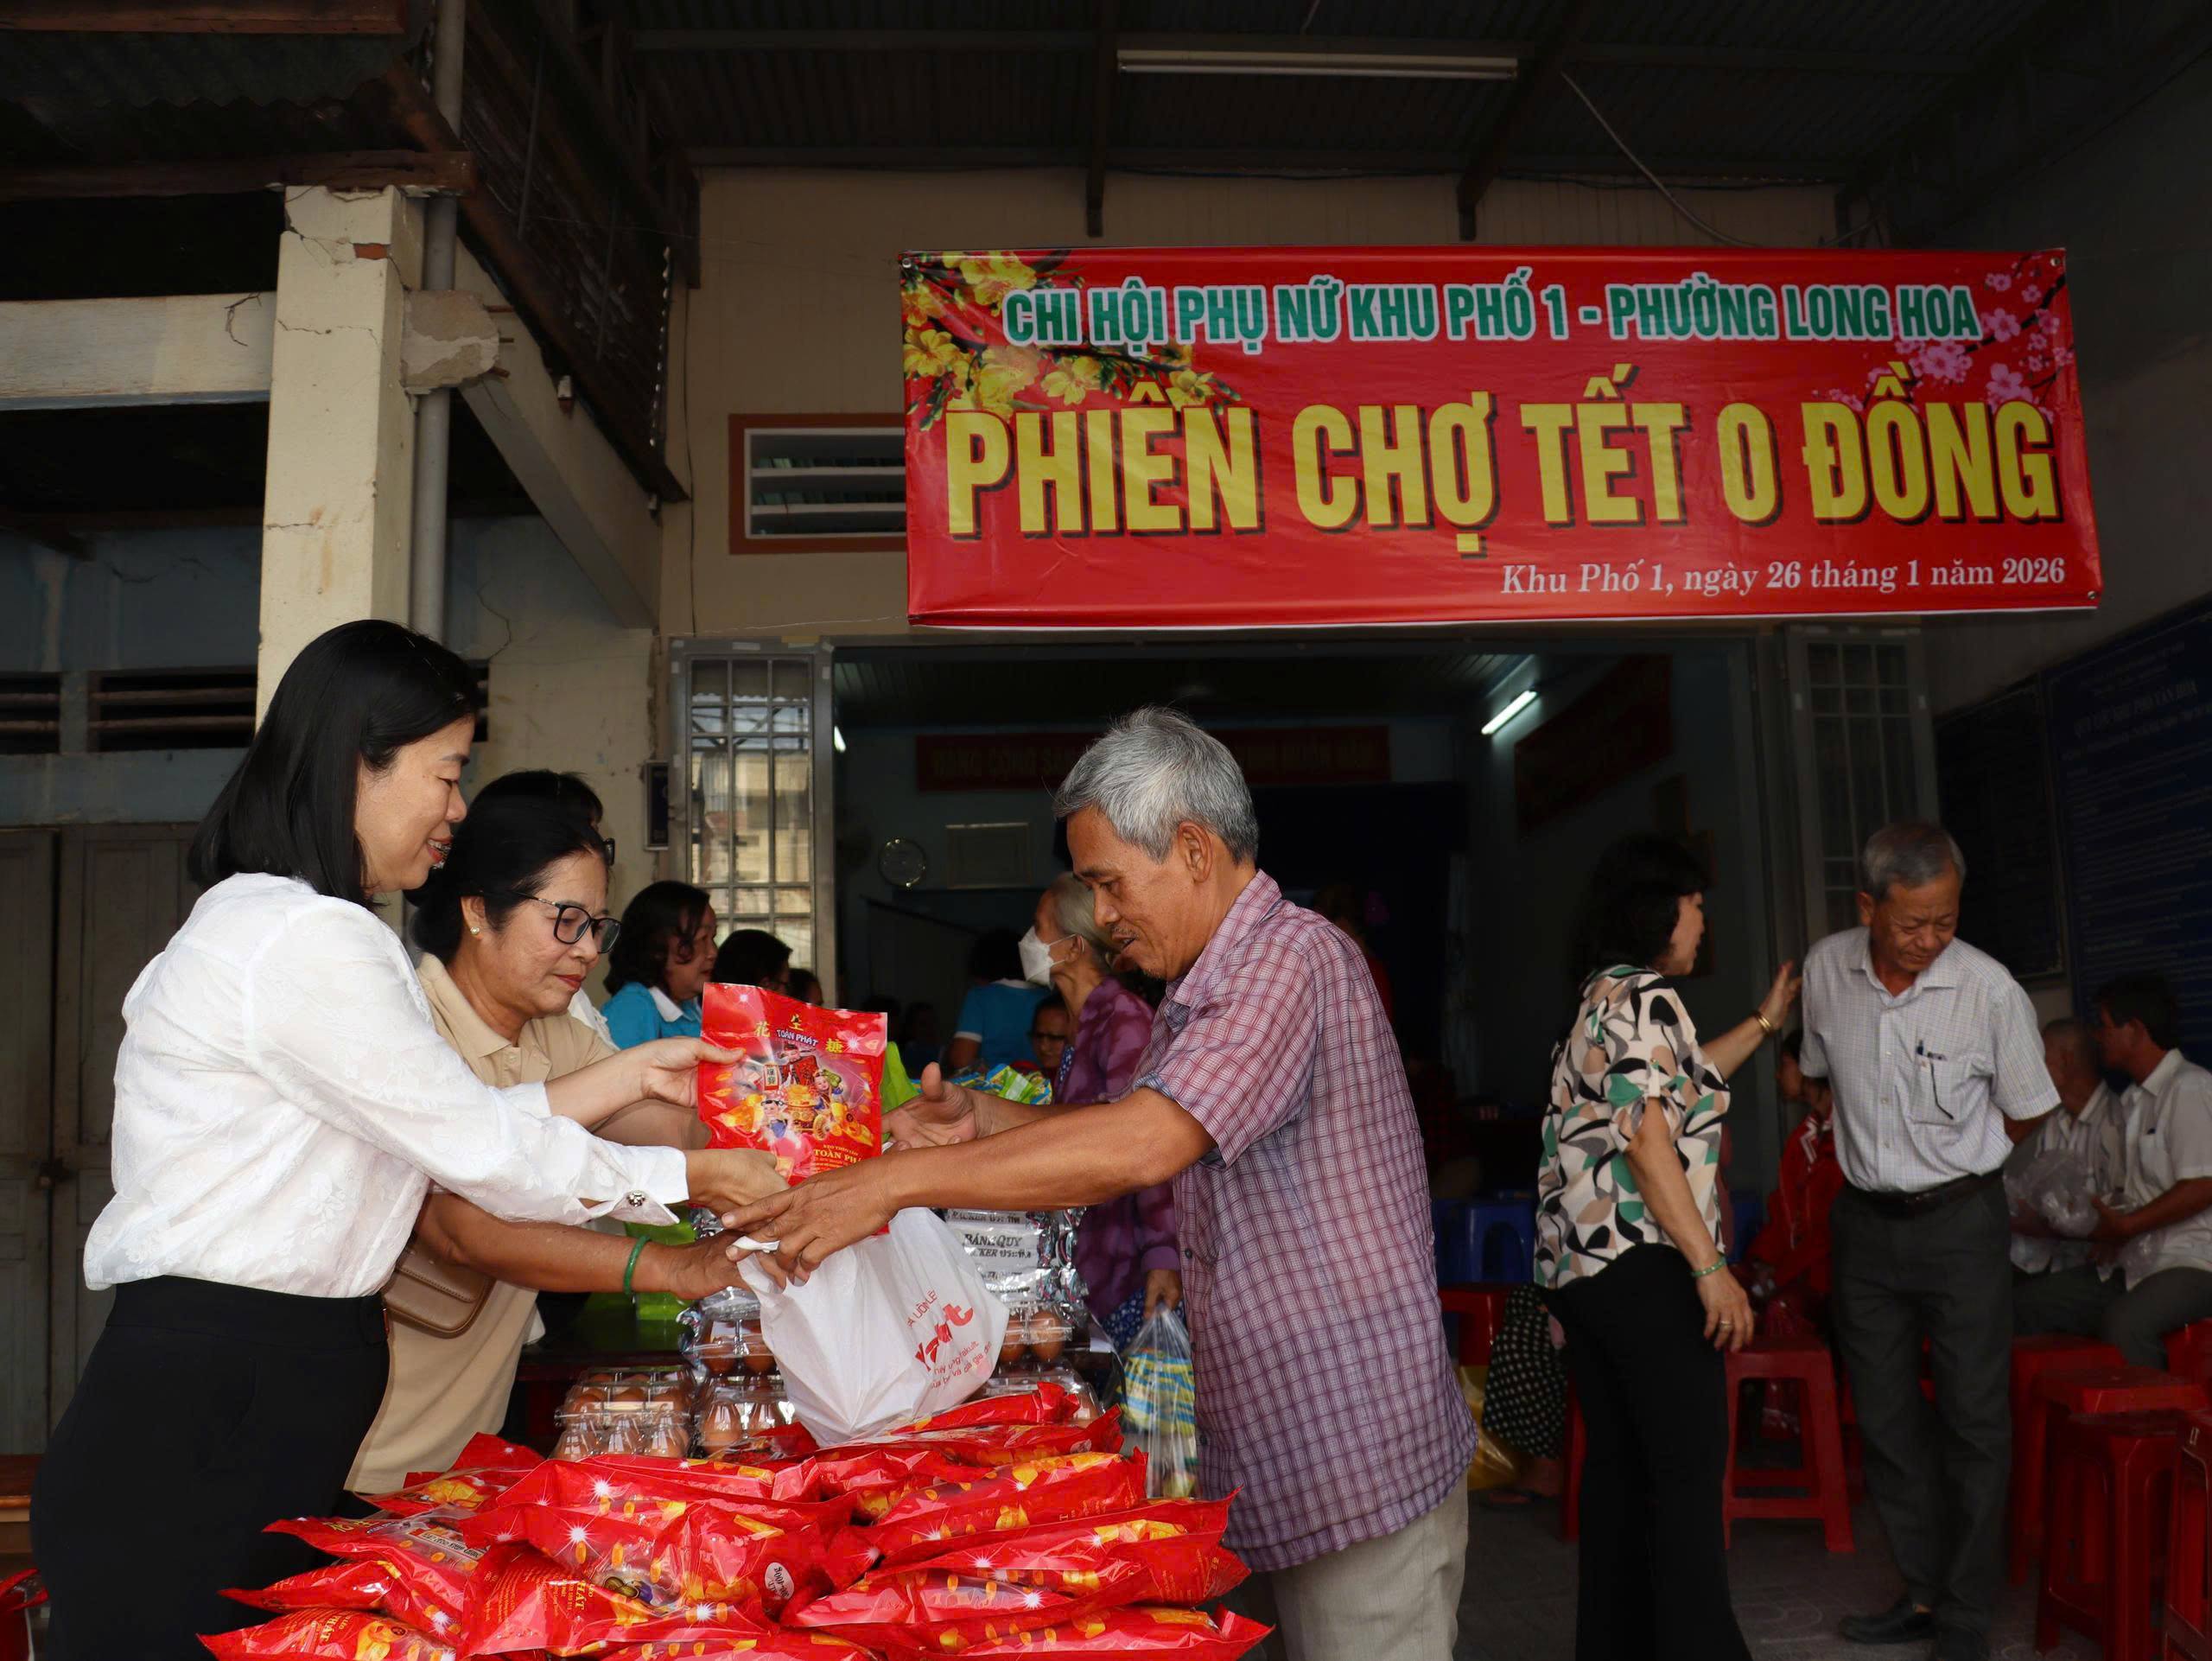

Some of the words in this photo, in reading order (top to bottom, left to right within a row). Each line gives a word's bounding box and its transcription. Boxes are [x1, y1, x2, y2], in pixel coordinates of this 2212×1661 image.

[1004, 283, 1080, 344] CHI
[1090, 277, 1166, 354] HỘI
[1176, 287, 1266, 353] PHỤ
[1275, 277, 1342, 340] NỮ
[1348, 285, 1437, 339] KHU
[1446, 269, 1534, 339] PHỐ
[1543, 286, 1567, 338] 1
[1608, 274, 1777, 338] PHƯỜNG
[1785, 286, 1891, 340] LONG
[1898, 287, 1981, 339] HOA
[945, 380, 1262, 536] PHIÊN
[1292, 391, 1497, 553] CHỢ
[1520, 363, 1687, 525] TẾT
[1802, 361, 2058, 522] ĐỒNG
[1500, 563, 1567, 595] Khu
[1579, 558, 1643, 594] Phố
[1651, 563, 1675, 597] 1,
[1683, 561, 1759, 597] ngày
[1766, 561, 1802, 589] 26
[1809, 558, 1897, 593] tháng
[1905, 561, 1919, 586] 1
[1930, 558, 1994, 586] năm
[2001, 557, 2066, 584] 2026
[776, 1028, 796, 1041] TOÀN
[795, 1033, 819, 1047] PHÁT
[813, 1149, 842, 1159] TOÀN
[996, 1235, 1023, 1248] QUY
